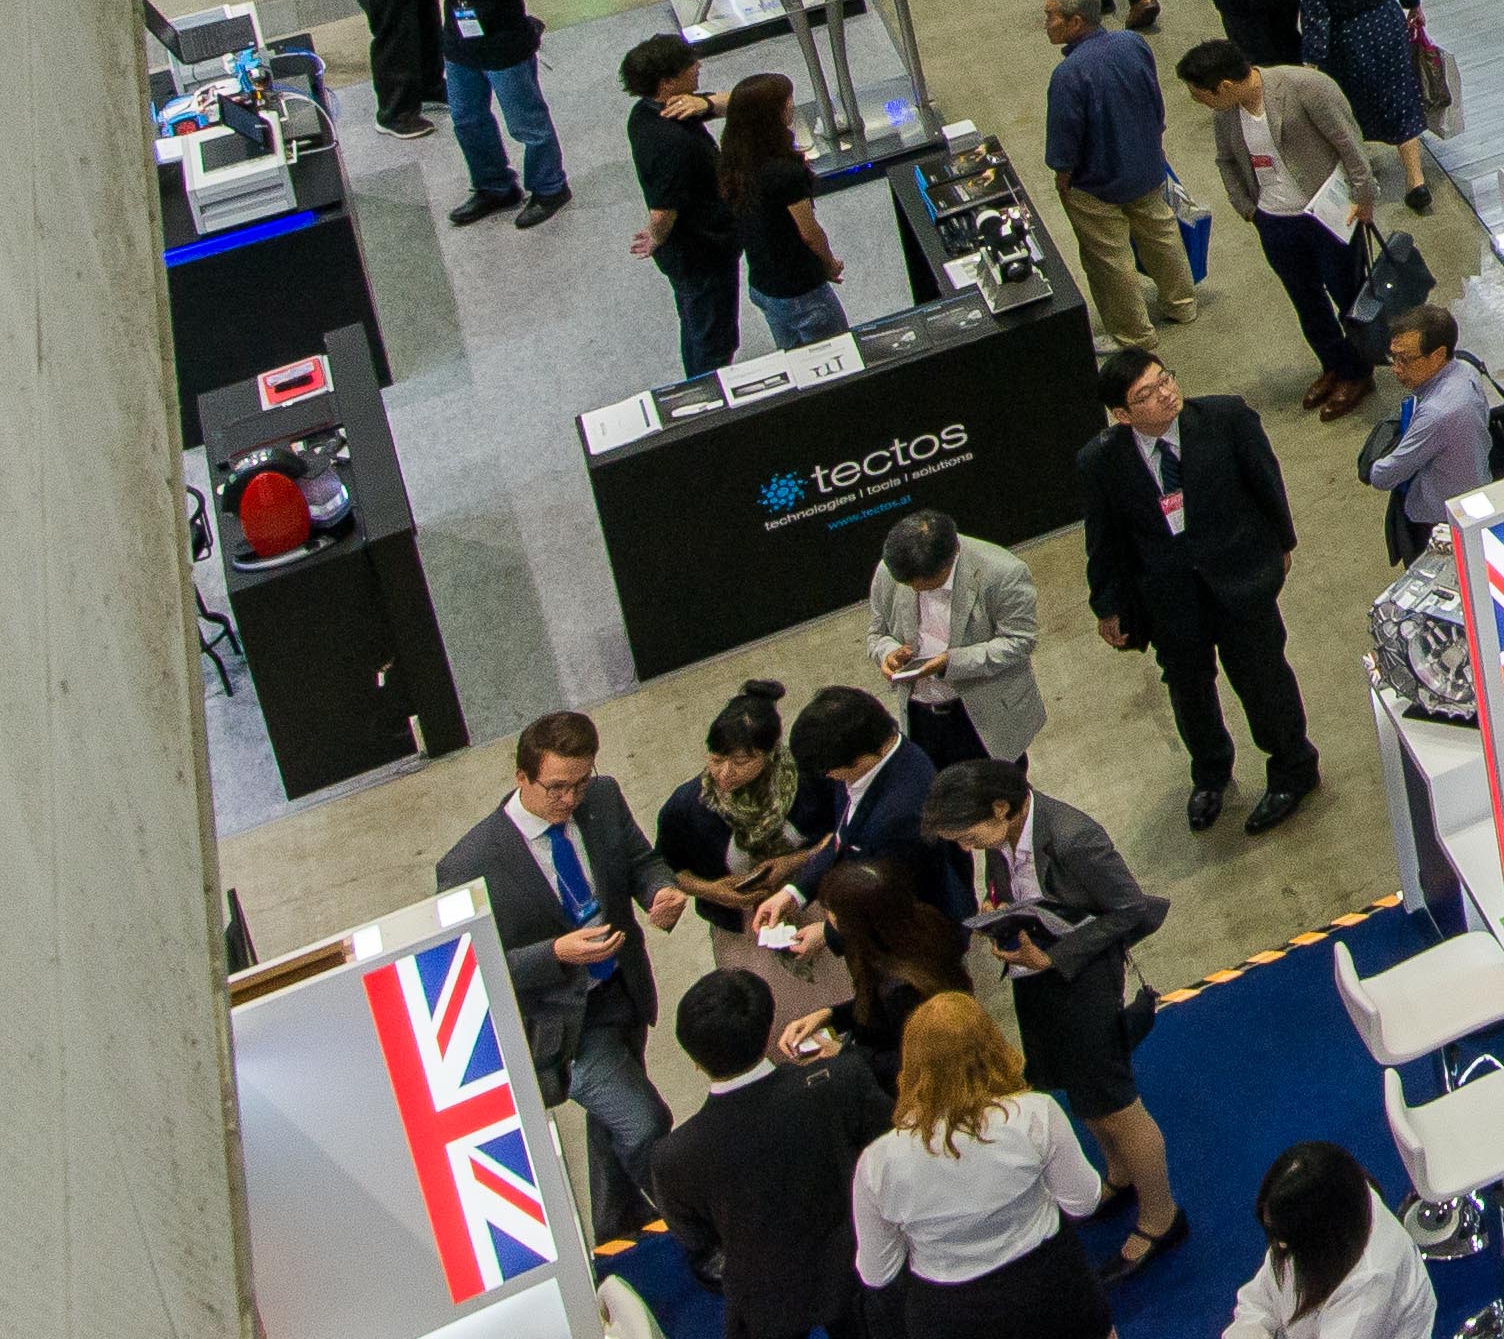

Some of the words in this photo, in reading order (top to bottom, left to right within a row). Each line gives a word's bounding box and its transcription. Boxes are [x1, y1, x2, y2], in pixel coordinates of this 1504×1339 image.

[764, 491, 857, 532] technologies
[867, 477, 901, 495] tools
[911, 451, 974, 482] solutions
[810, 422, 969, 495] tectos
[826, 494, 912, 531] www.tectos.at
